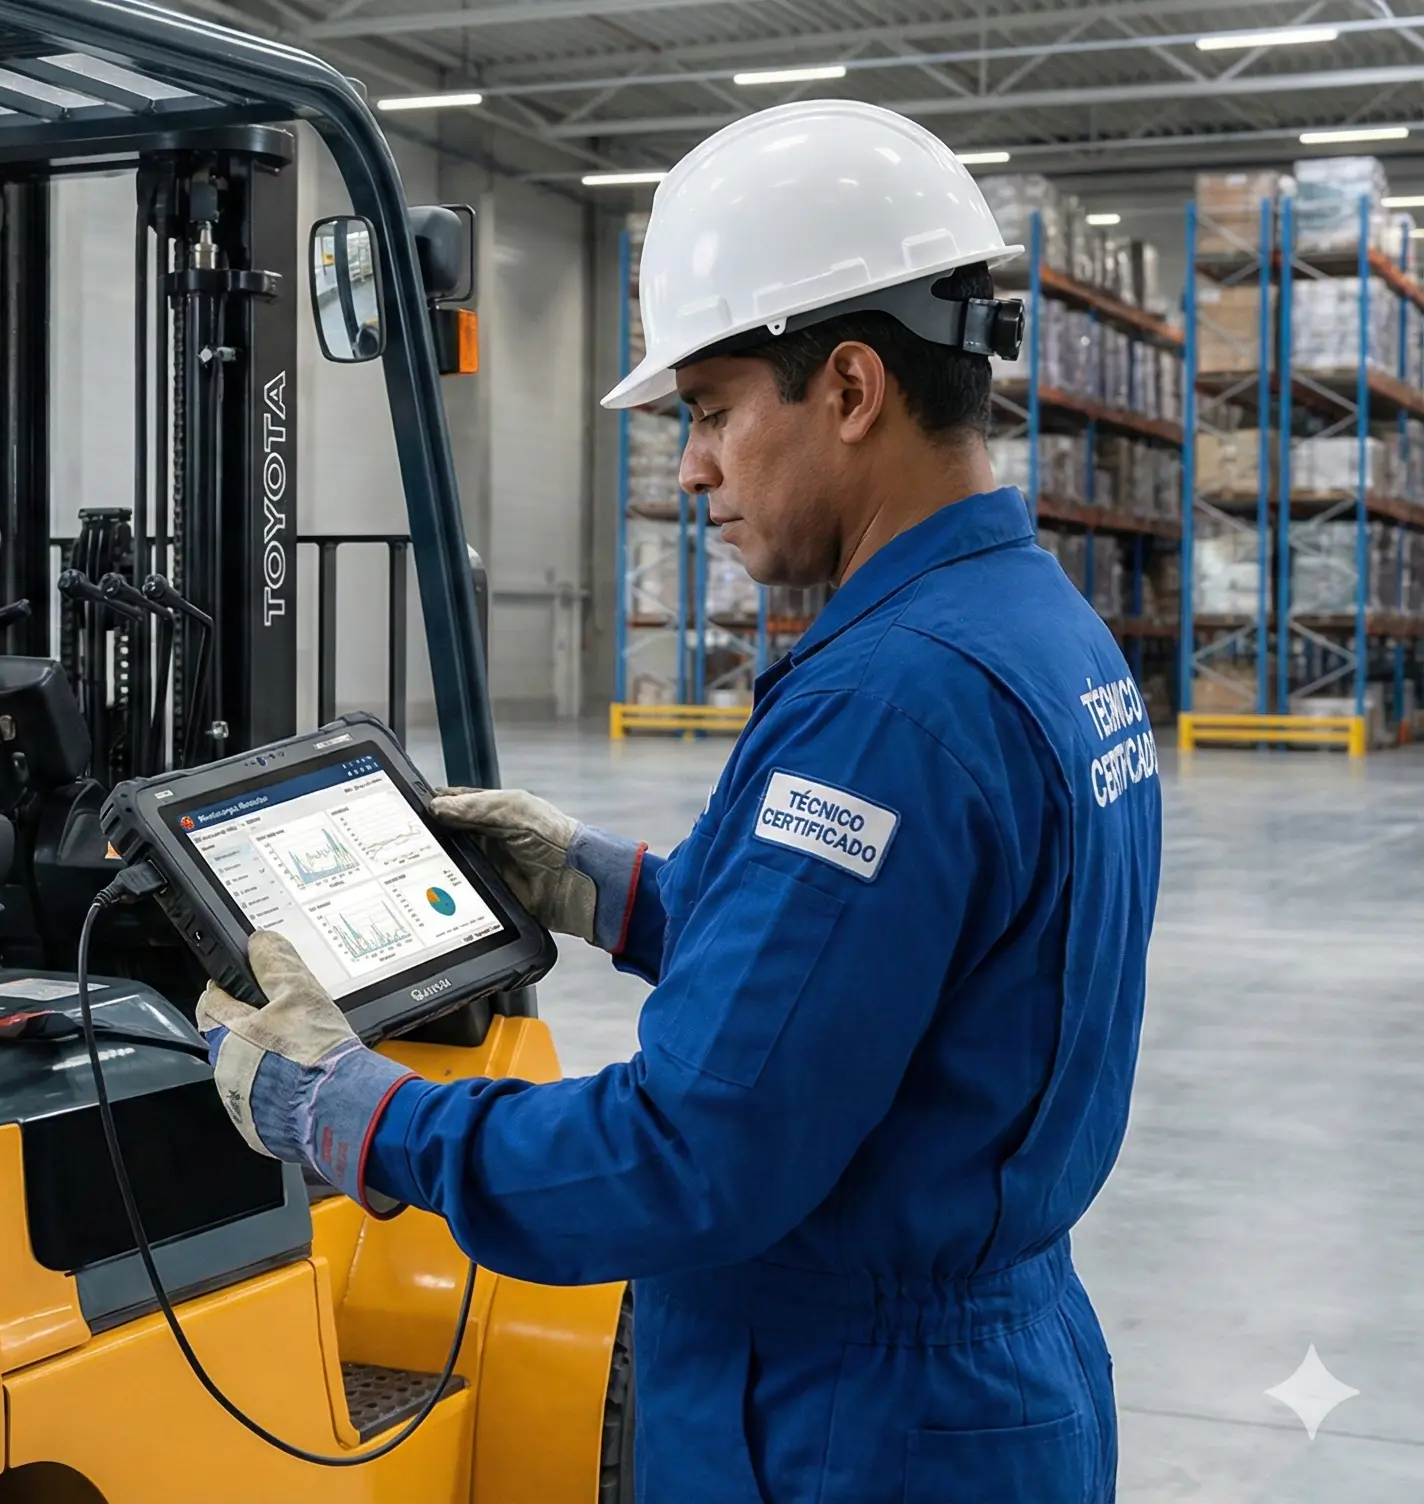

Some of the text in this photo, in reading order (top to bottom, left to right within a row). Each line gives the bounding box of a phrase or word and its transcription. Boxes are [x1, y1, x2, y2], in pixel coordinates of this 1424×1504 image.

[264, 370, 286, 626] TOYOTA
[762, 807, 877, 863] CERTIFICADO
[789, 789, 865, 832] TÉCNICO
